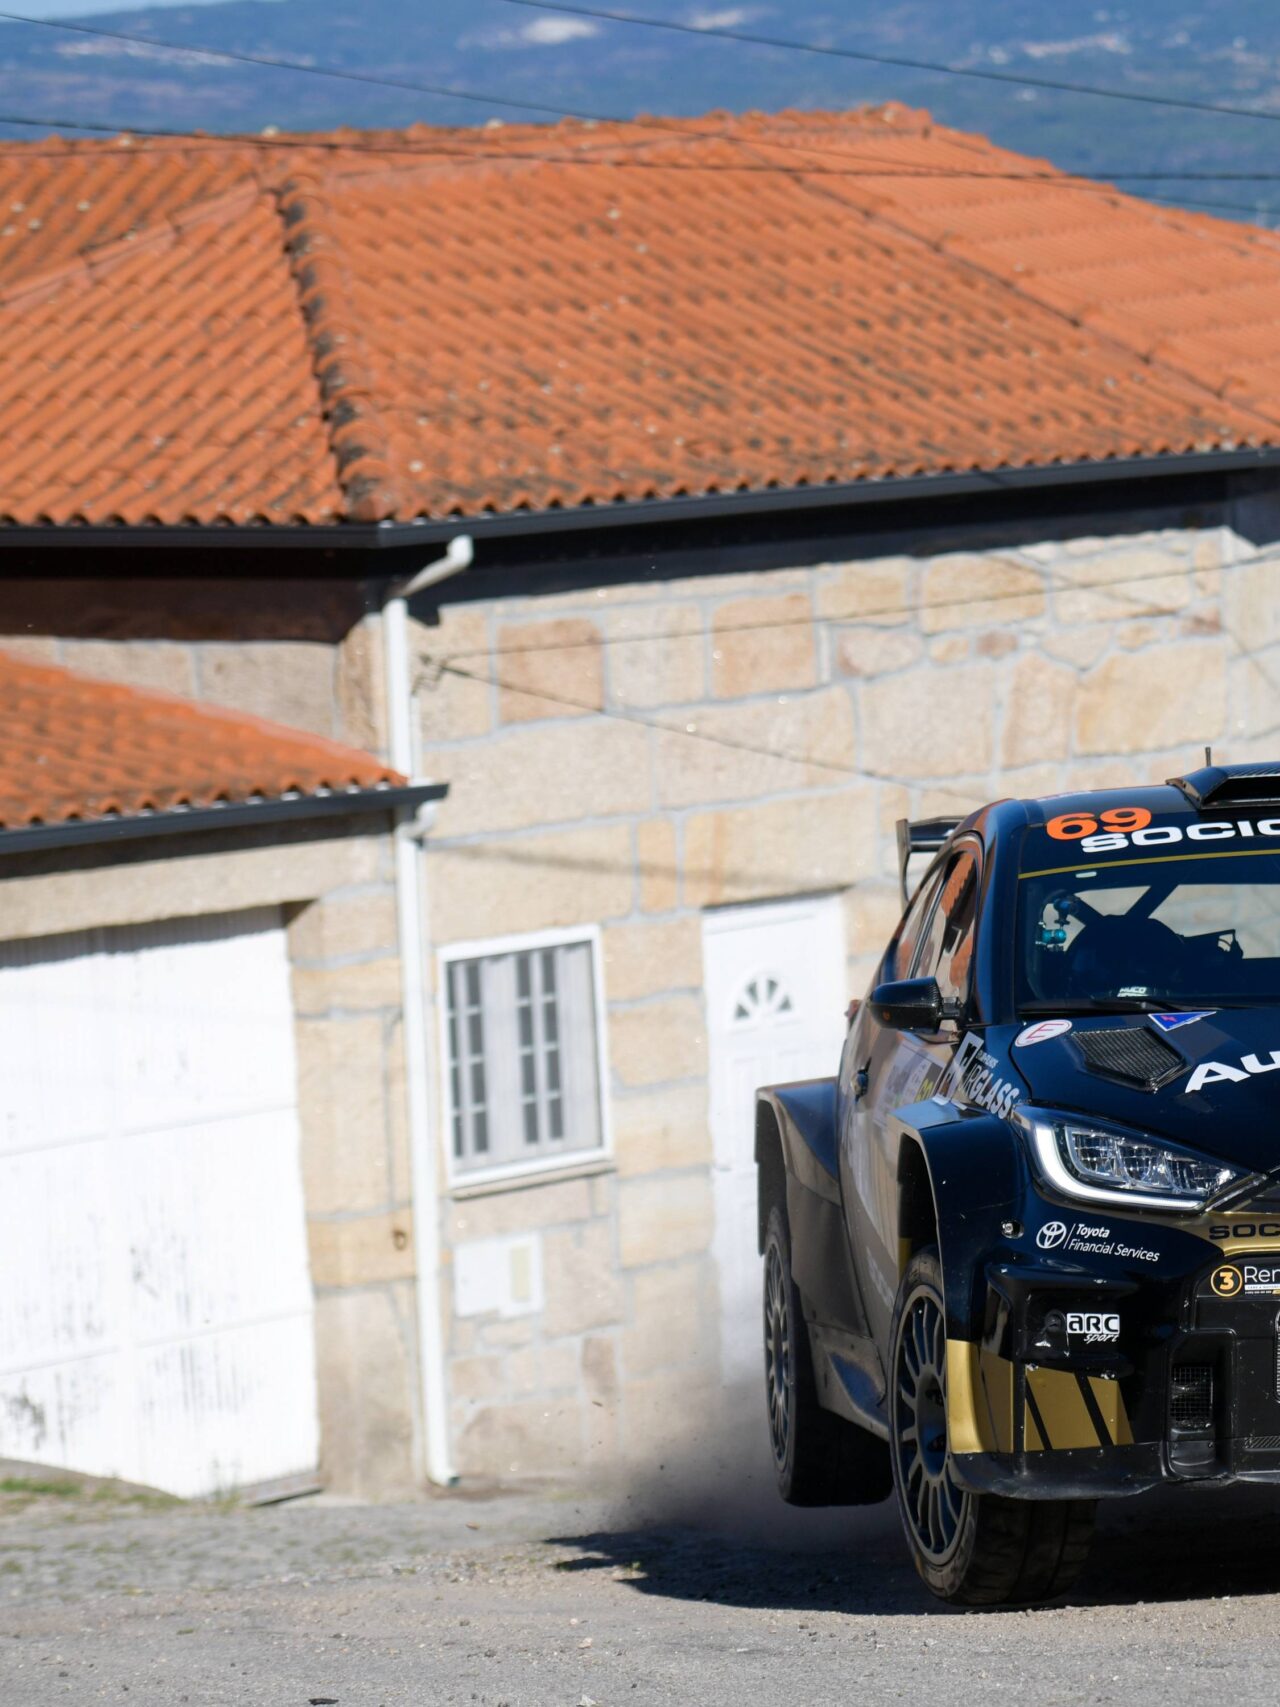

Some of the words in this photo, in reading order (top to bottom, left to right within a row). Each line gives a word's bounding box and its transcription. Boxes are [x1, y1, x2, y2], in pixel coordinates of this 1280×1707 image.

[1046, 807, 1152, 840] 69
[1076, 1223, 1110, 1239] Toyota
[1068, 1239, 1115, 1254] Financial
[1114, 1244, 1160, 1262] Services
[1219, 1271, 1235, 1290] 3
[1084, 1333, 1120, 1344] sport
